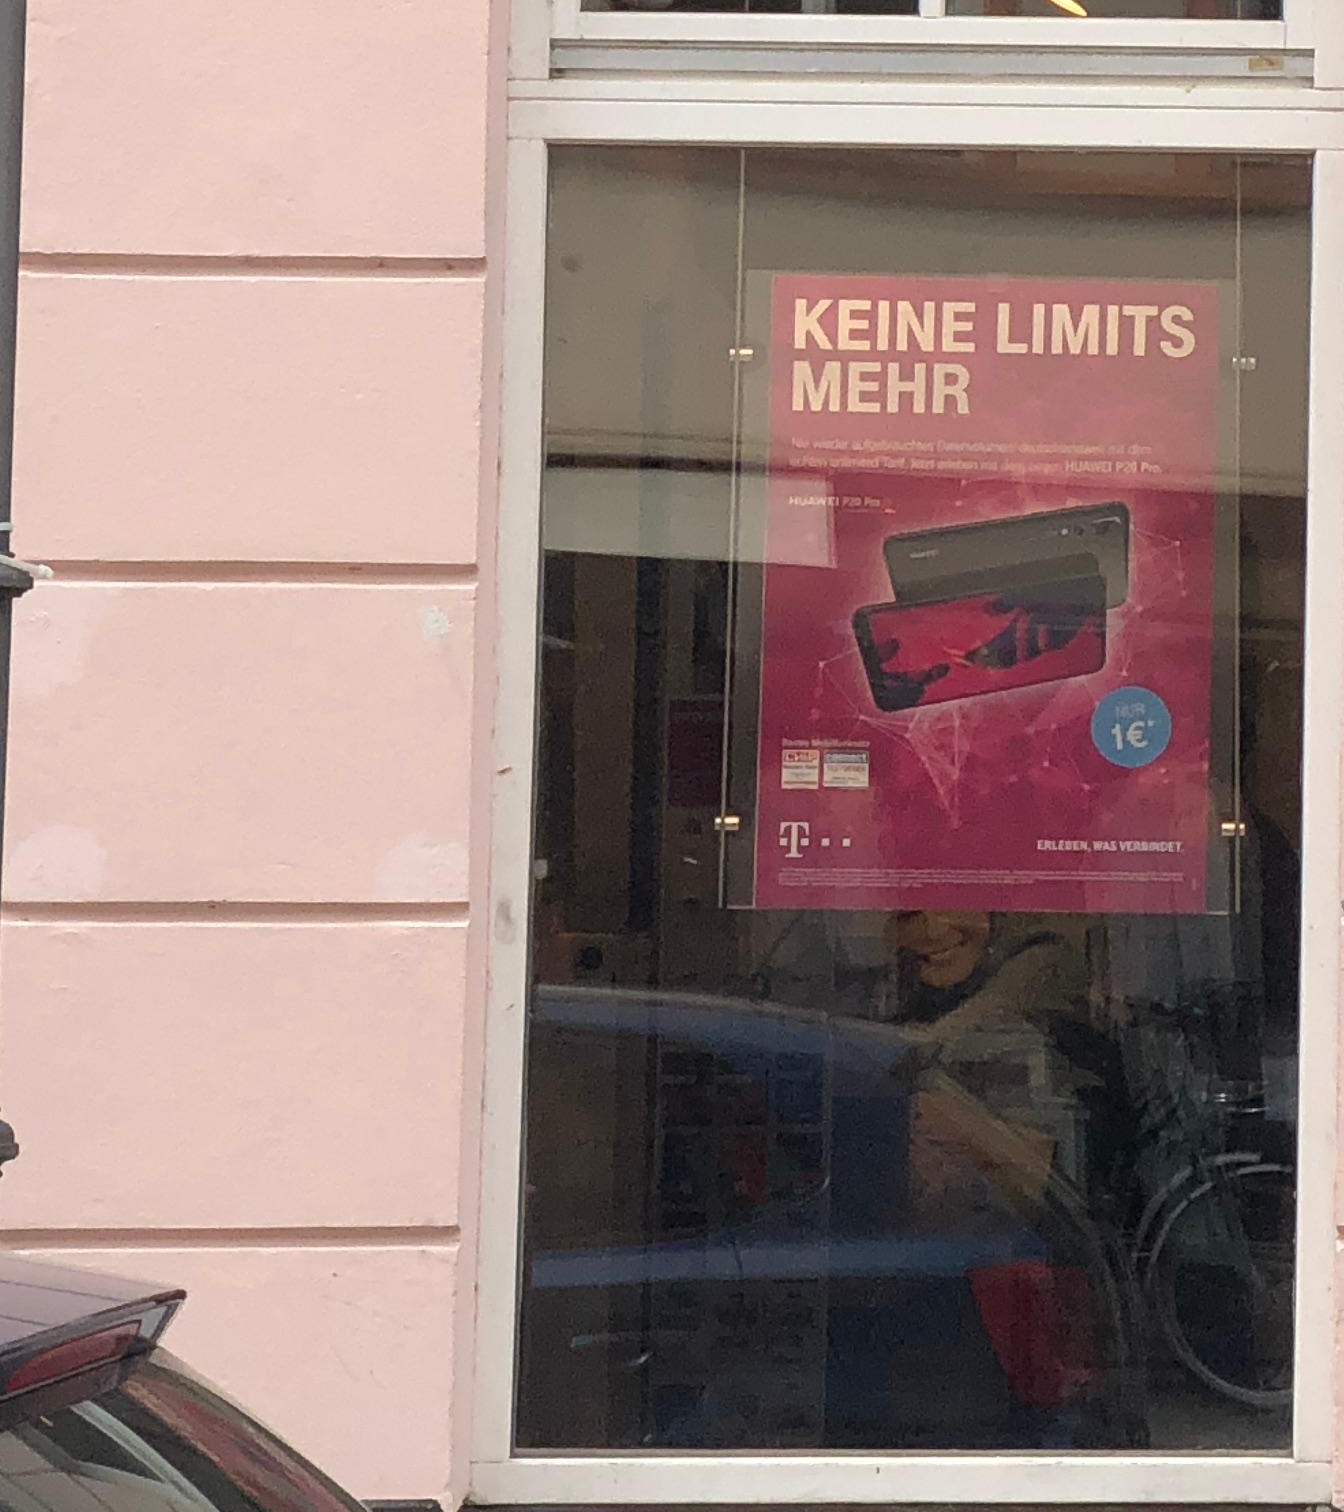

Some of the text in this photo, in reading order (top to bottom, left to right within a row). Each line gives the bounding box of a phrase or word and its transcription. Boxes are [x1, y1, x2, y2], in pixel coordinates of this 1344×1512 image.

[793, 298, 1196, 357] KEINE LIMITS
[791, 361, 971, 415] MEHR
[1065, 460, 1112, 473] HUAWEI
[1115, 461, 1137, 473] P20
[789, 496, 839, 506] HUAWEI
